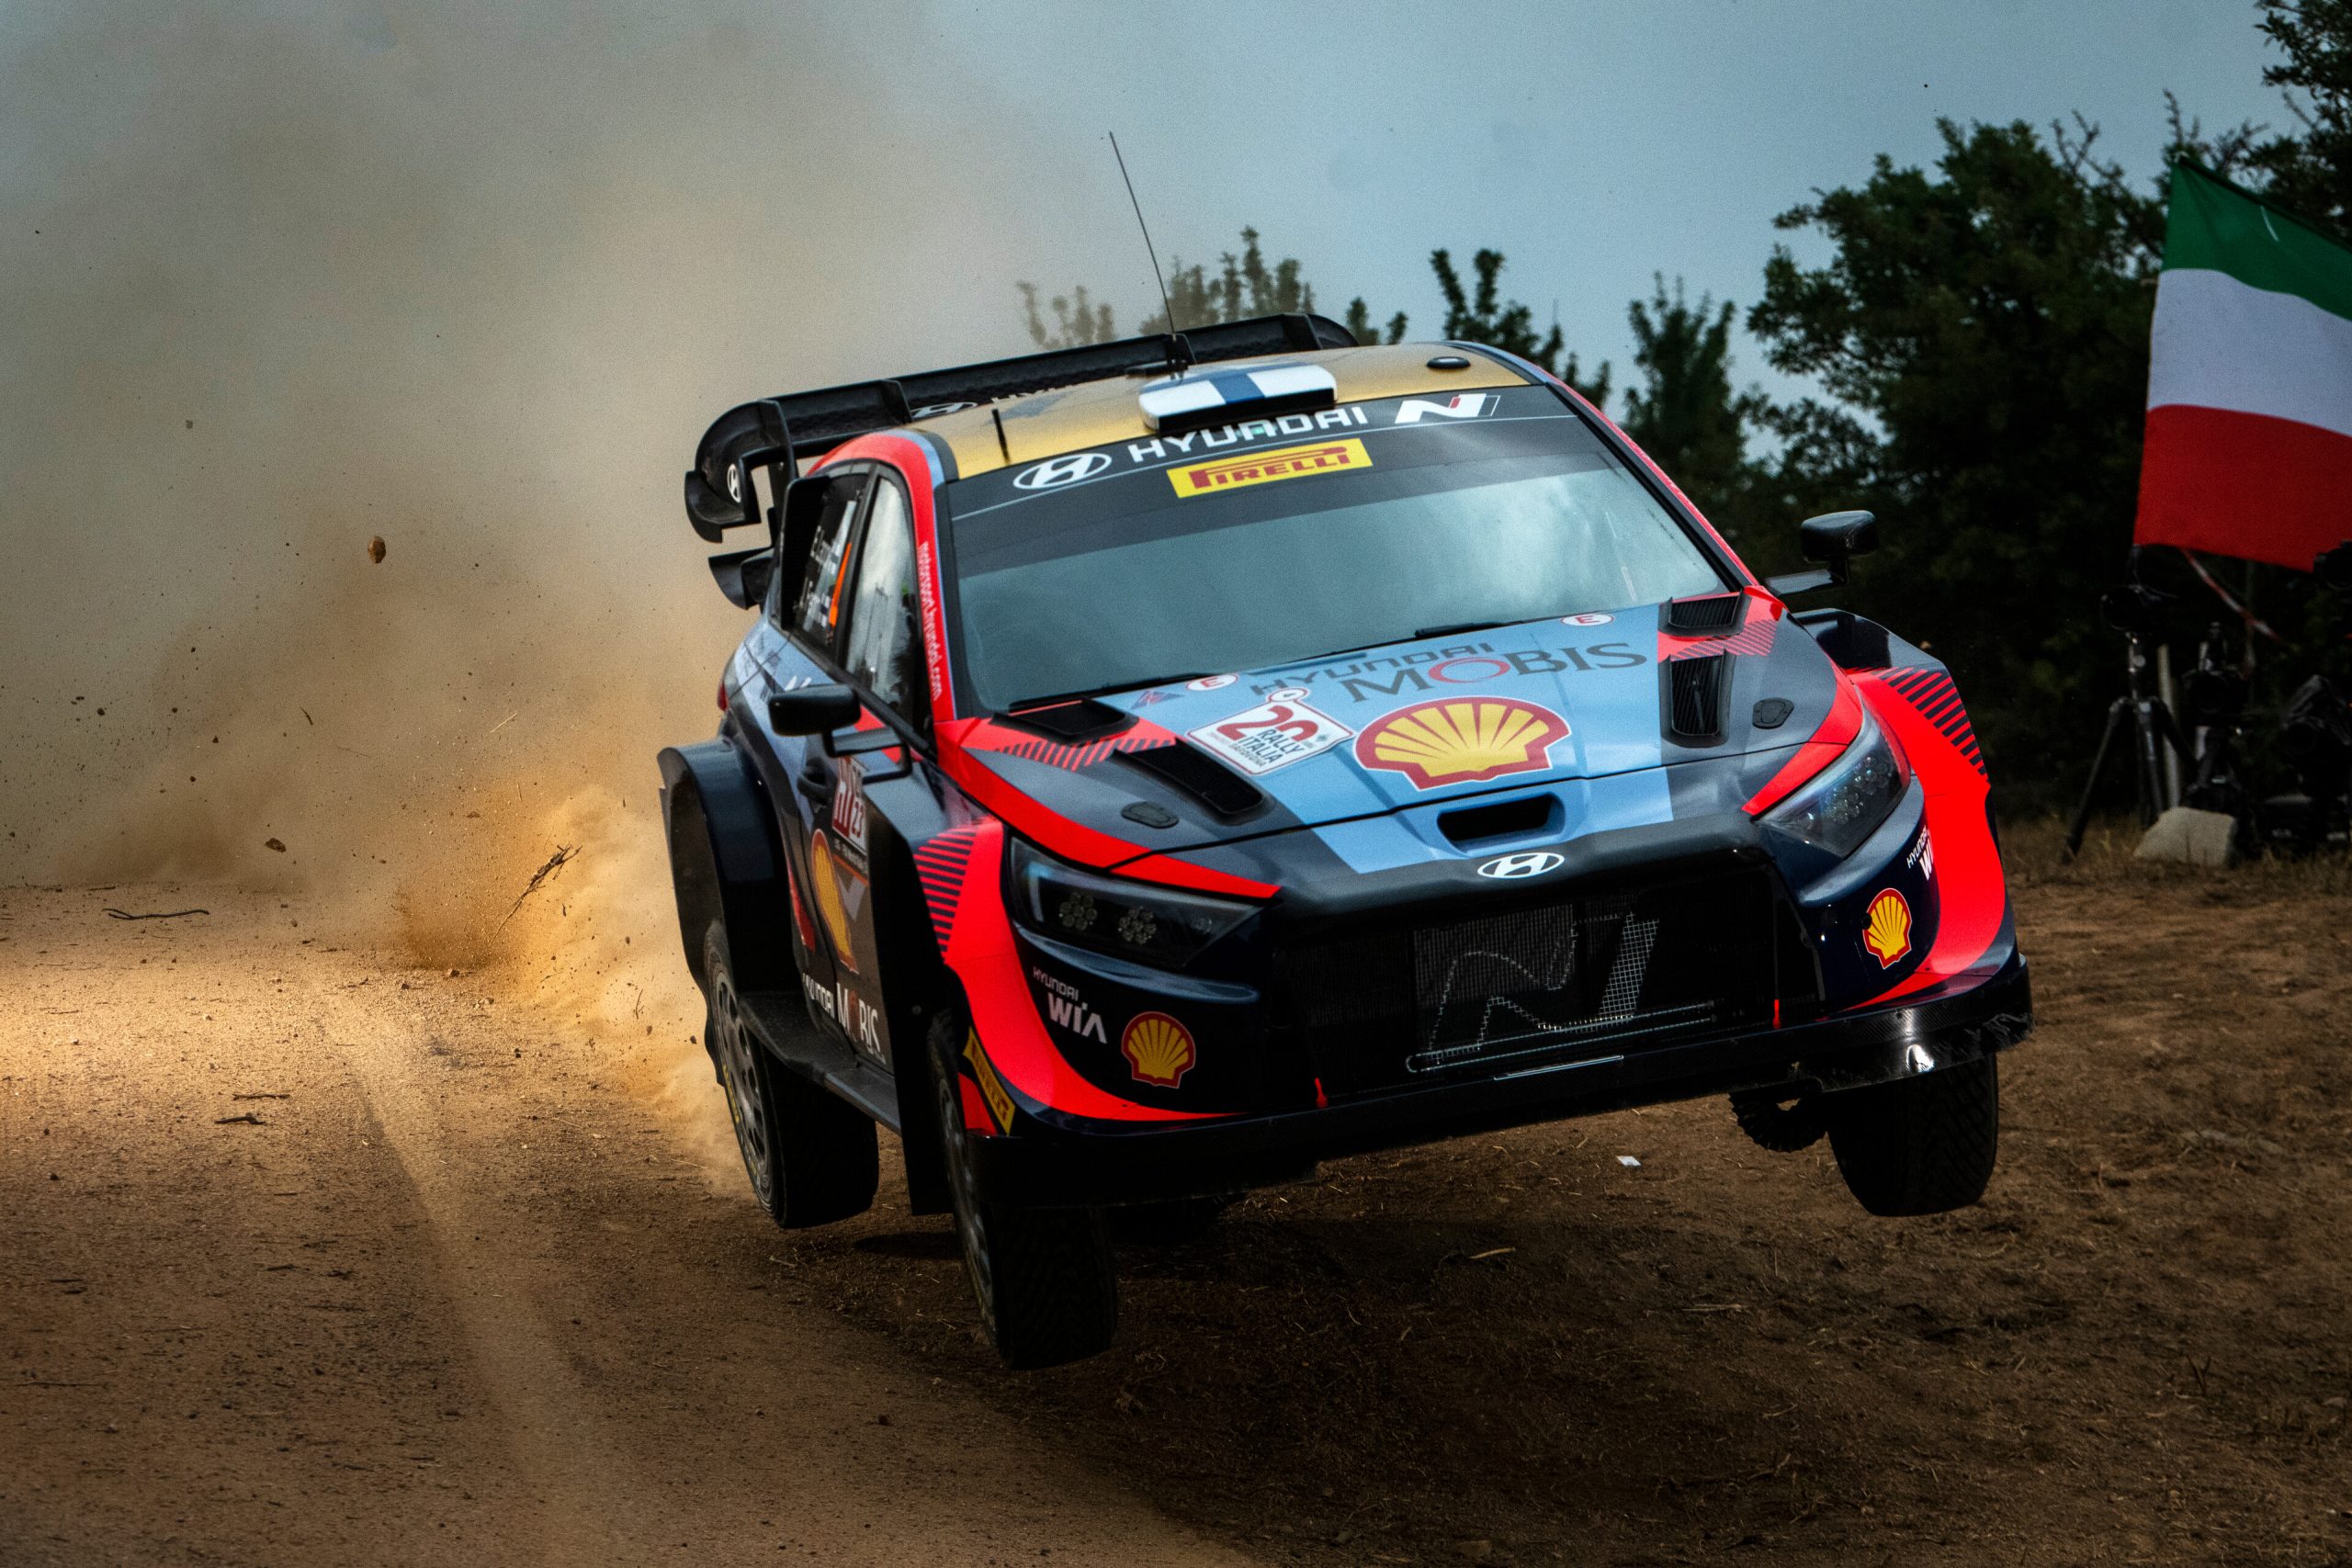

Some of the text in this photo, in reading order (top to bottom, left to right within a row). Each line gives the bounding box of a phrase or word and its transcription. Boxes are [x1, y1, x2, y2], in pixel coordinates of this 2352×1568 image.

[1128, 407, 1368, 463] HYUNDAI
[1189, 446, 1351, 489] PIRELLI
[1575, 615, 1600, 624] E
[1200, 677, 1225, 688] E
[1250, 642, 1495, 695] HYUNDAI
[1340, 643, 1647, 703] MOBIS
[1238, 736, 1283, 763] ITALIA
[1257, 728, 1305, 754] RALLY
[1034, 965, 1079, 1001] HYUNDAI
